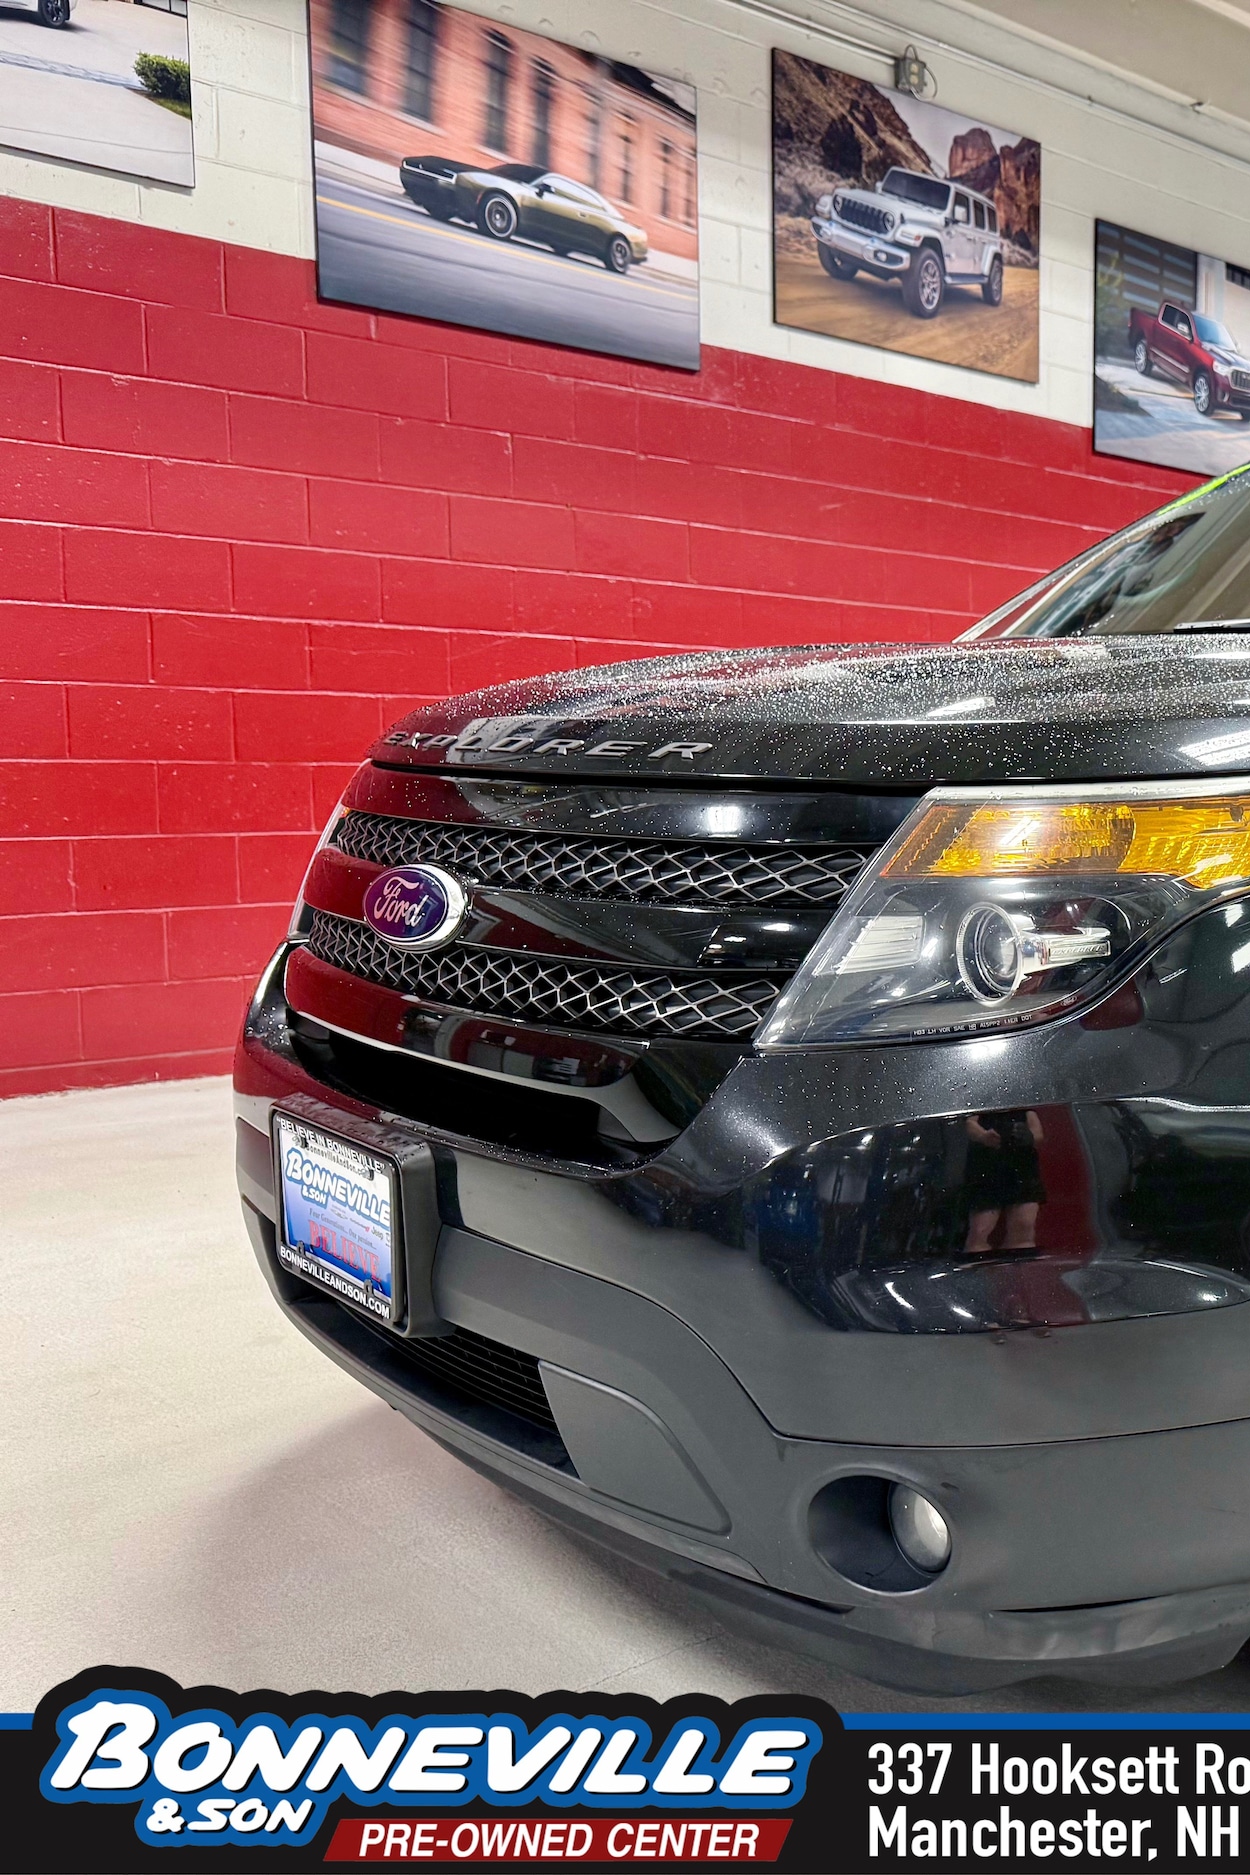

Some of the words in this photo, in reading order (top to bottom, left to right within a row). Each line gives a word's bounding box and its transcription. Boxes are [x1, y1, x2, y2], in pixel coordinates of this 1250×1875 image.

[382, 731, 714, 760] EXPLORER
[373, 876, 427, 927] Ford
[316, 1132, 325, 1147] IN
[287, 1151, 390, 1223] BONNEVILLE
[308, 1219, 382, 1283] BELIEVE
[280, 1245, 390, 1320] BONNEVILLEANDSON.COM
